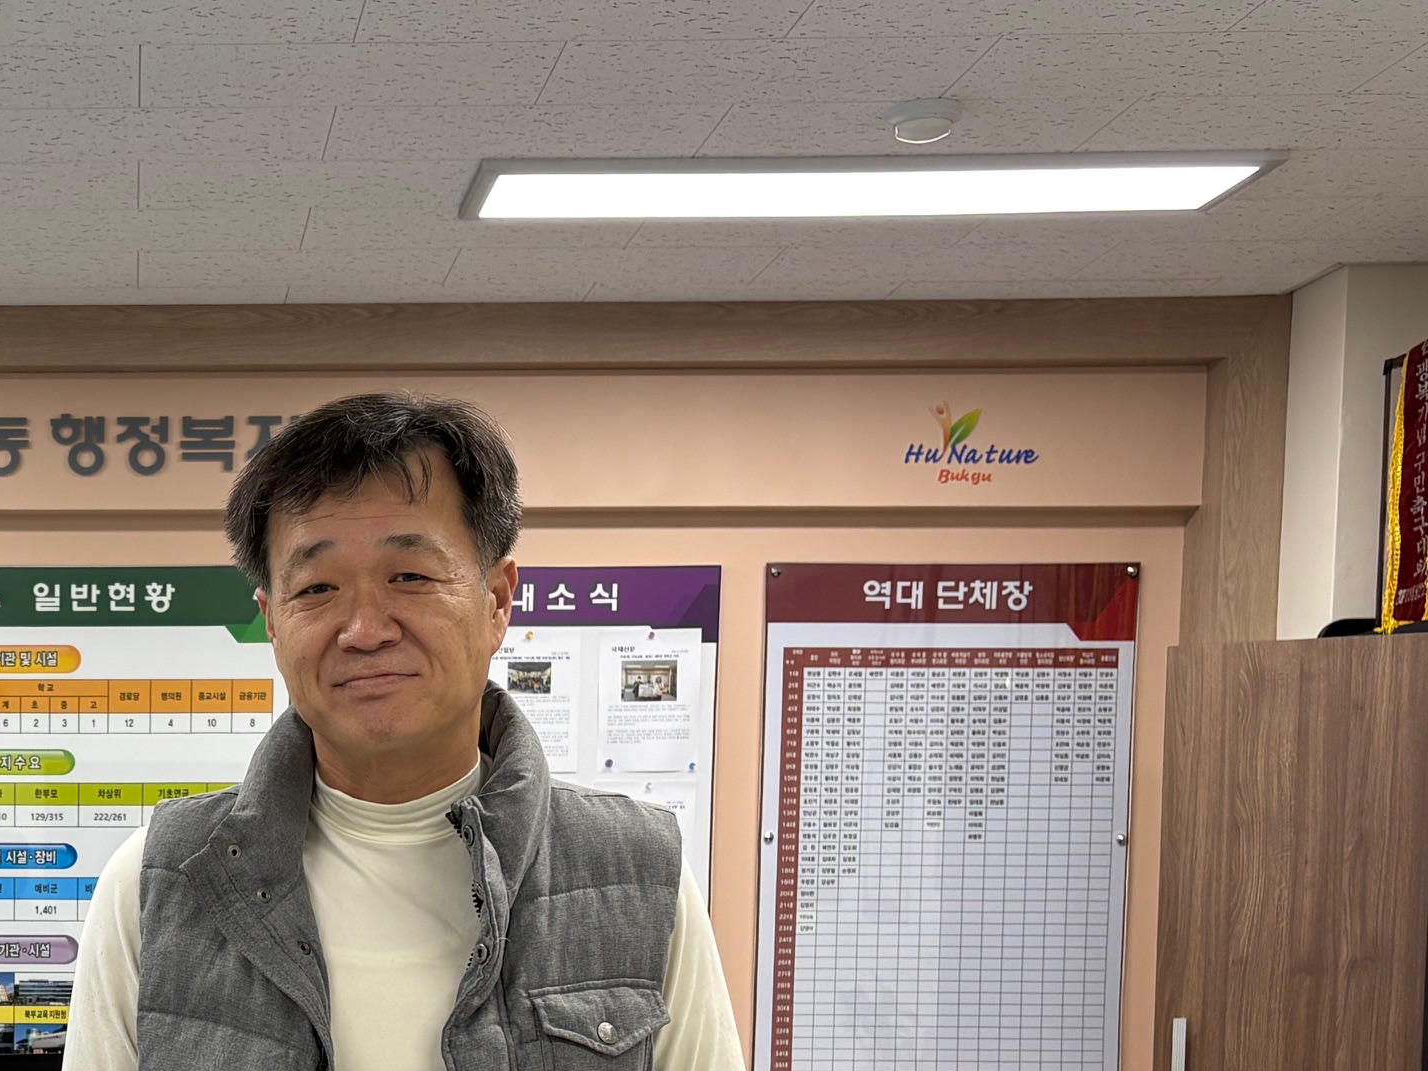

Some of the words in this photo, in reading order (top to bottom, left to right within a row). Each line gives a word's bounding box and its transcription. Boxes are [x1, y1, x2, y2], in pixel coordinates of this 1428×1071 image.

[937, 468, 992, 485] Bukgu
[33, 582, 176, 613] 일반현황
[863, 580, 924, 610] 역대
[937, 580, 1033, 611] 단체장
[20, 651, 31, 667] 및
[35, 651, 58, 667] 시설
[2, 719, 8, 727] 6
[33, 719, 39, 727] 2
[61, 719, 67, 727] 3
[125, 719, 133, 727] 12
[168, 719, 173, 727] 4
[207, 719, 216, 727] 10
[249, 719, 255, 727] 8
[34, 789, 58, 799] 한부모
[97, 789, 121, 799] 차상위
[31, 812, 63, 822] 129/315
[94, 812, 127, 822] 222/261
[34, 883, 58, 893] 예비군
[35, 906, 57, 915] 1,401
